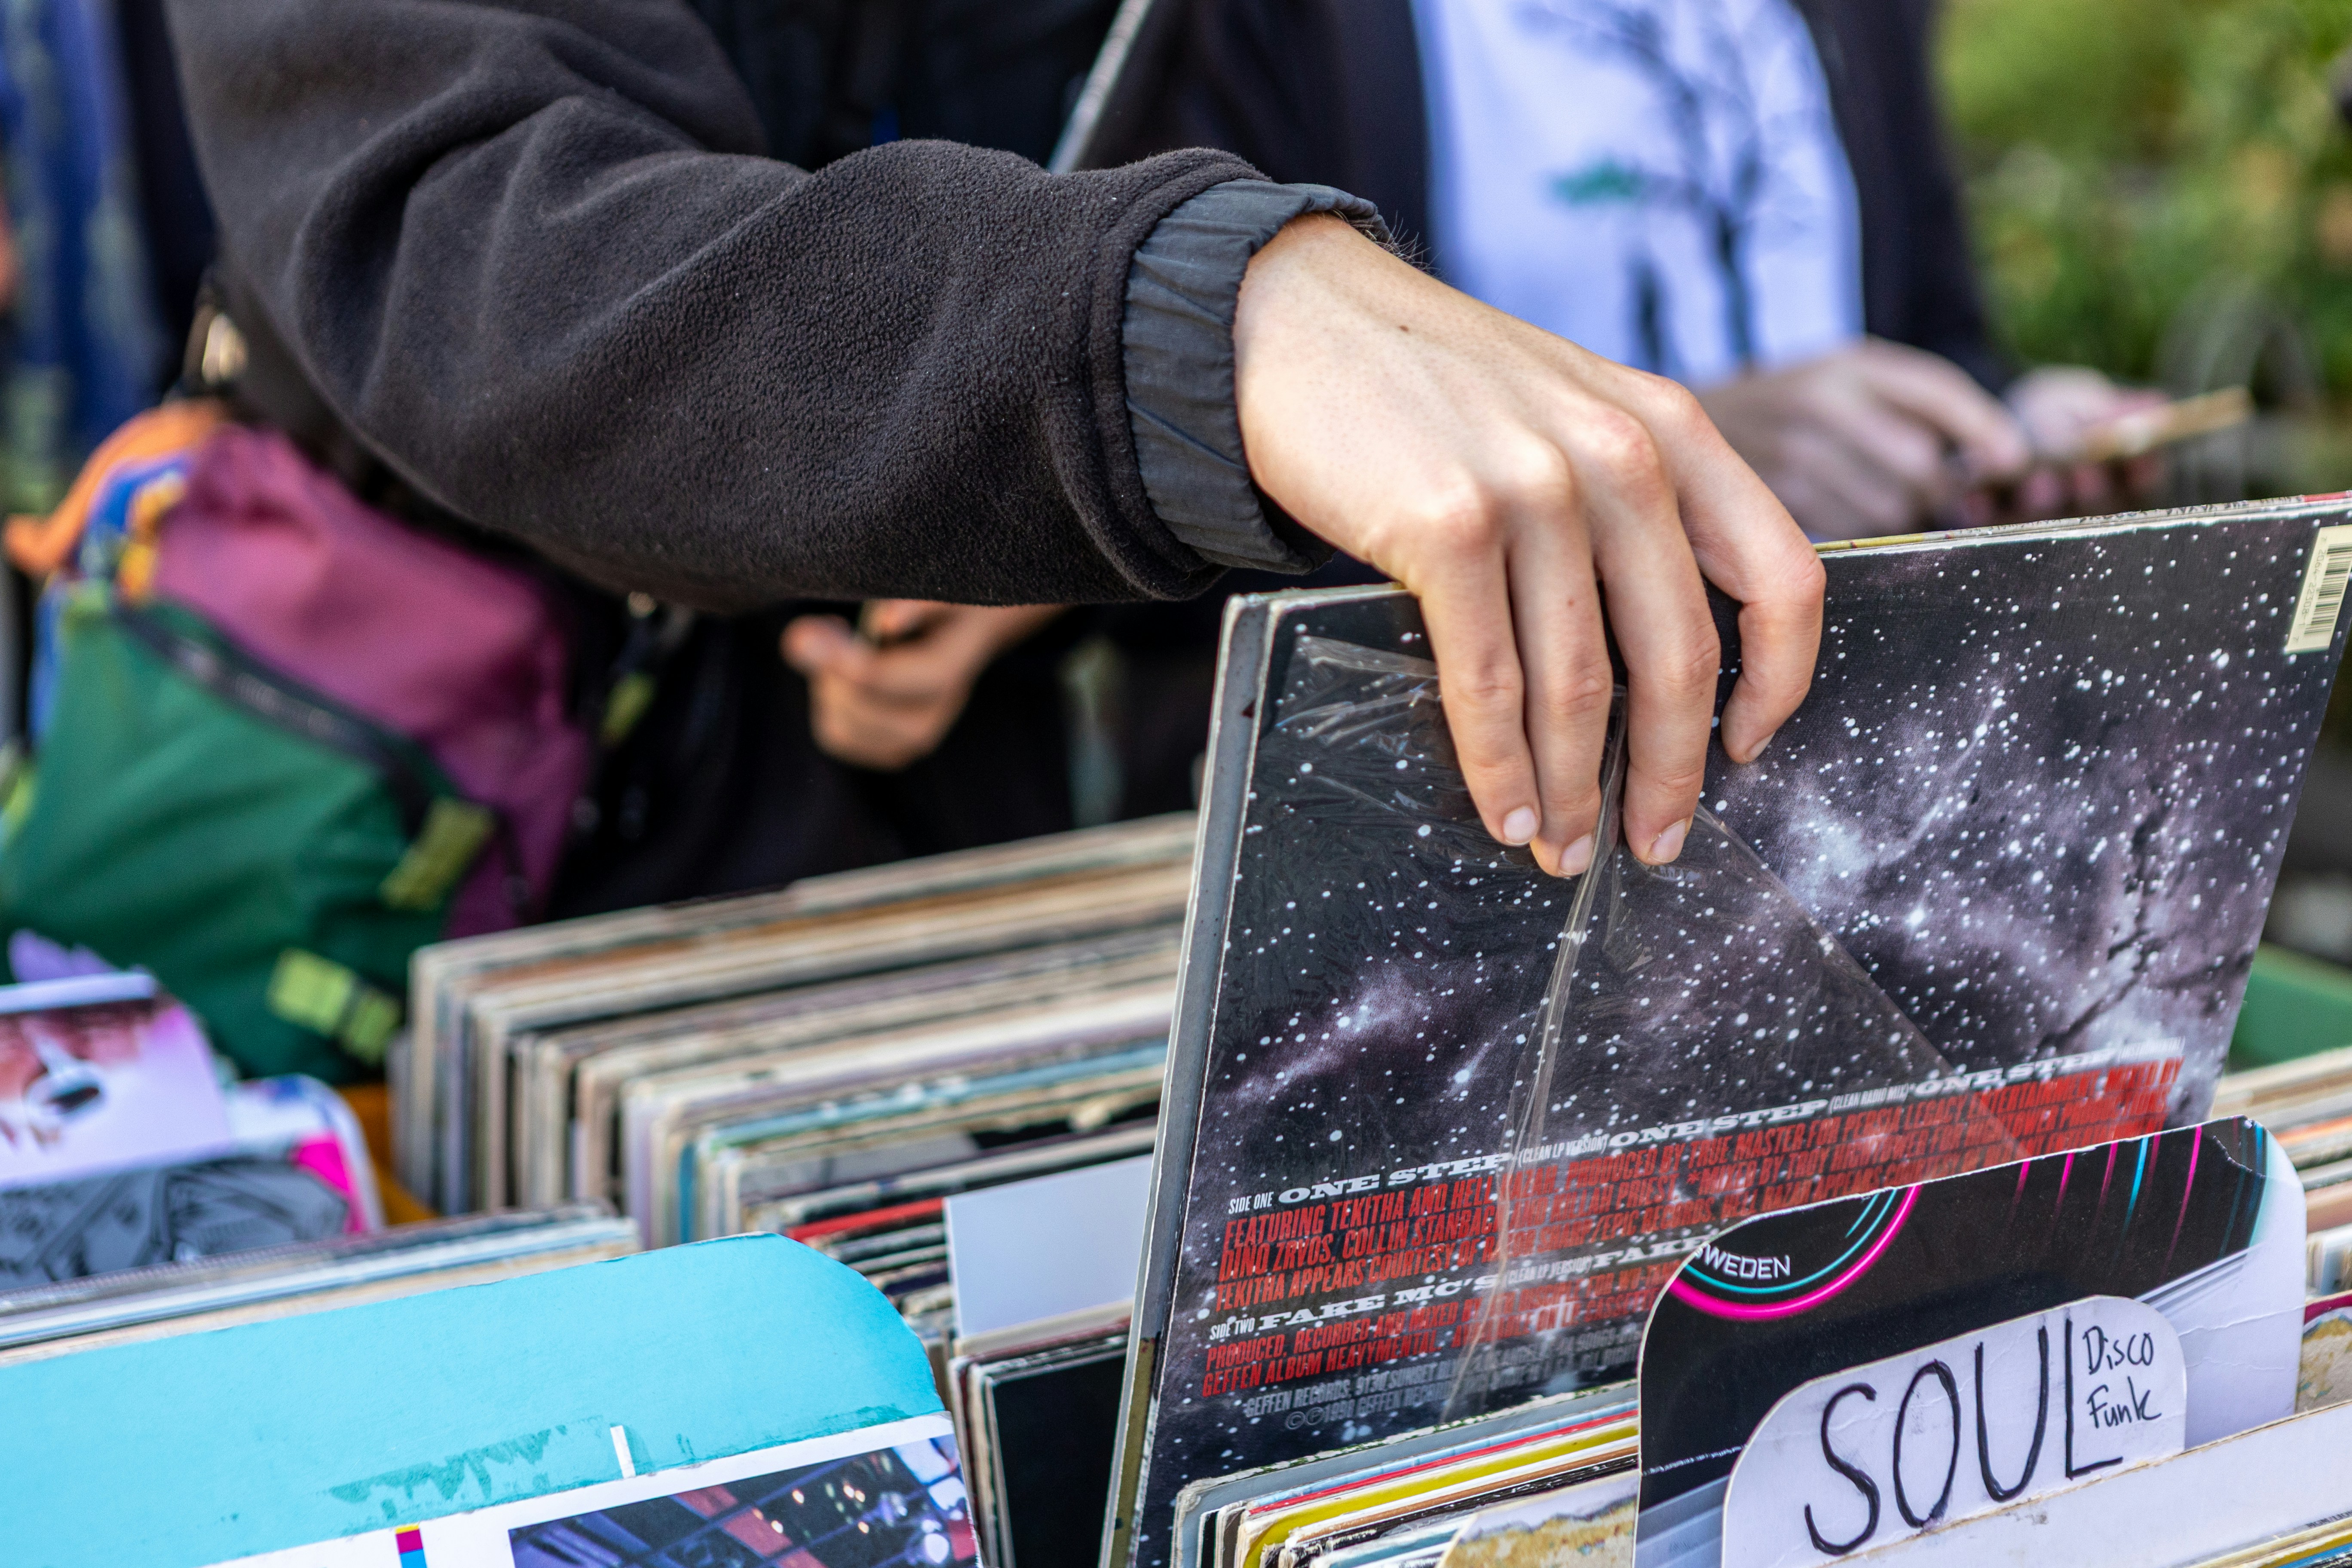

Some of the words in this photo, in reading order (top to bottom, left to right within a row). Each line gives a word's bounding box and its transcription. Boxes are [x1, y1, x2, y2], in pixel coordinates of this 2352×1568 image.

[1229, 1195, 1251, 1214] SIDE
[1254, 1191, 1274, 1208] ONE
[1278, 1174, 1381, 1204] ONE
[1388, 1152, 1513, 1186] STEP
[1609, 1119, 1705, 1147] ONE
[1711, 1099, 1829, 1131] STEP
[1915, 1068, 2003, 1095] ONE
[1219, 1243, 1271, 1282] DINO
[1342, 1219, 1409, 1259] COLLIN
[1509, 1196, 1548, 1230] AND
[1550, 1184, 1614, 1222] KILLAH
[1758, 1155, 1784, 1185] BY
[1785, 1145, 1831, 1180] TROY
[1224, 1204, 1325, 1248] FEATURING
[1331, 1191, 1405, 1231] TEKITHA
[1409, 1184, 1448, 1218] AND
[1451, 1176, 1494, 1210] HELL
[1565, 1148, 1658, 1190] PRODUCED
[1659, 1144, 1686, 1173] BY
[1688, 1136, 1733, 1169] TRUE
[1734, 1123, 1806, 1161] MASTER
[1807, 1116, 1841, 1148] FOR
[1210, 1323, 1232, 1340] SIDE
[1235, 1317, 1256, 1334] TWO
[1258, 1294, 1385, 1331] FAKE
[1393, 1274, 1501, 1305] MC'S
[1216, 1272, 1286, 1312] TEKITHA
[1289, 1258, 1366, 1298] APPEARS
[1369, 1243, 1457, 1283] COURTESY
[1458, 1237, 1481, 1267] OF
[1206, 1334, 1286, 1371] PRODUCED,
[1294, 1317, 1371, 1354] RECORDED
[1373, 1311, 1406, 1337] AND
[1409, 1302, 1458, 1331] MIXED
[1462, 1296, 1483, 1322] BY
[2082, 1326, 2154, 1375] Disco
[1202, 1363, 1262, 1397] GEFFEN
[1265, 1351, 1323, 1384] ALBUM
[1246, 1390, 1292, 1418] GEFFEN
[2086, 1376, 2162, 1429] Funk
[1805, 1317, 2123, 1556] SOUL
